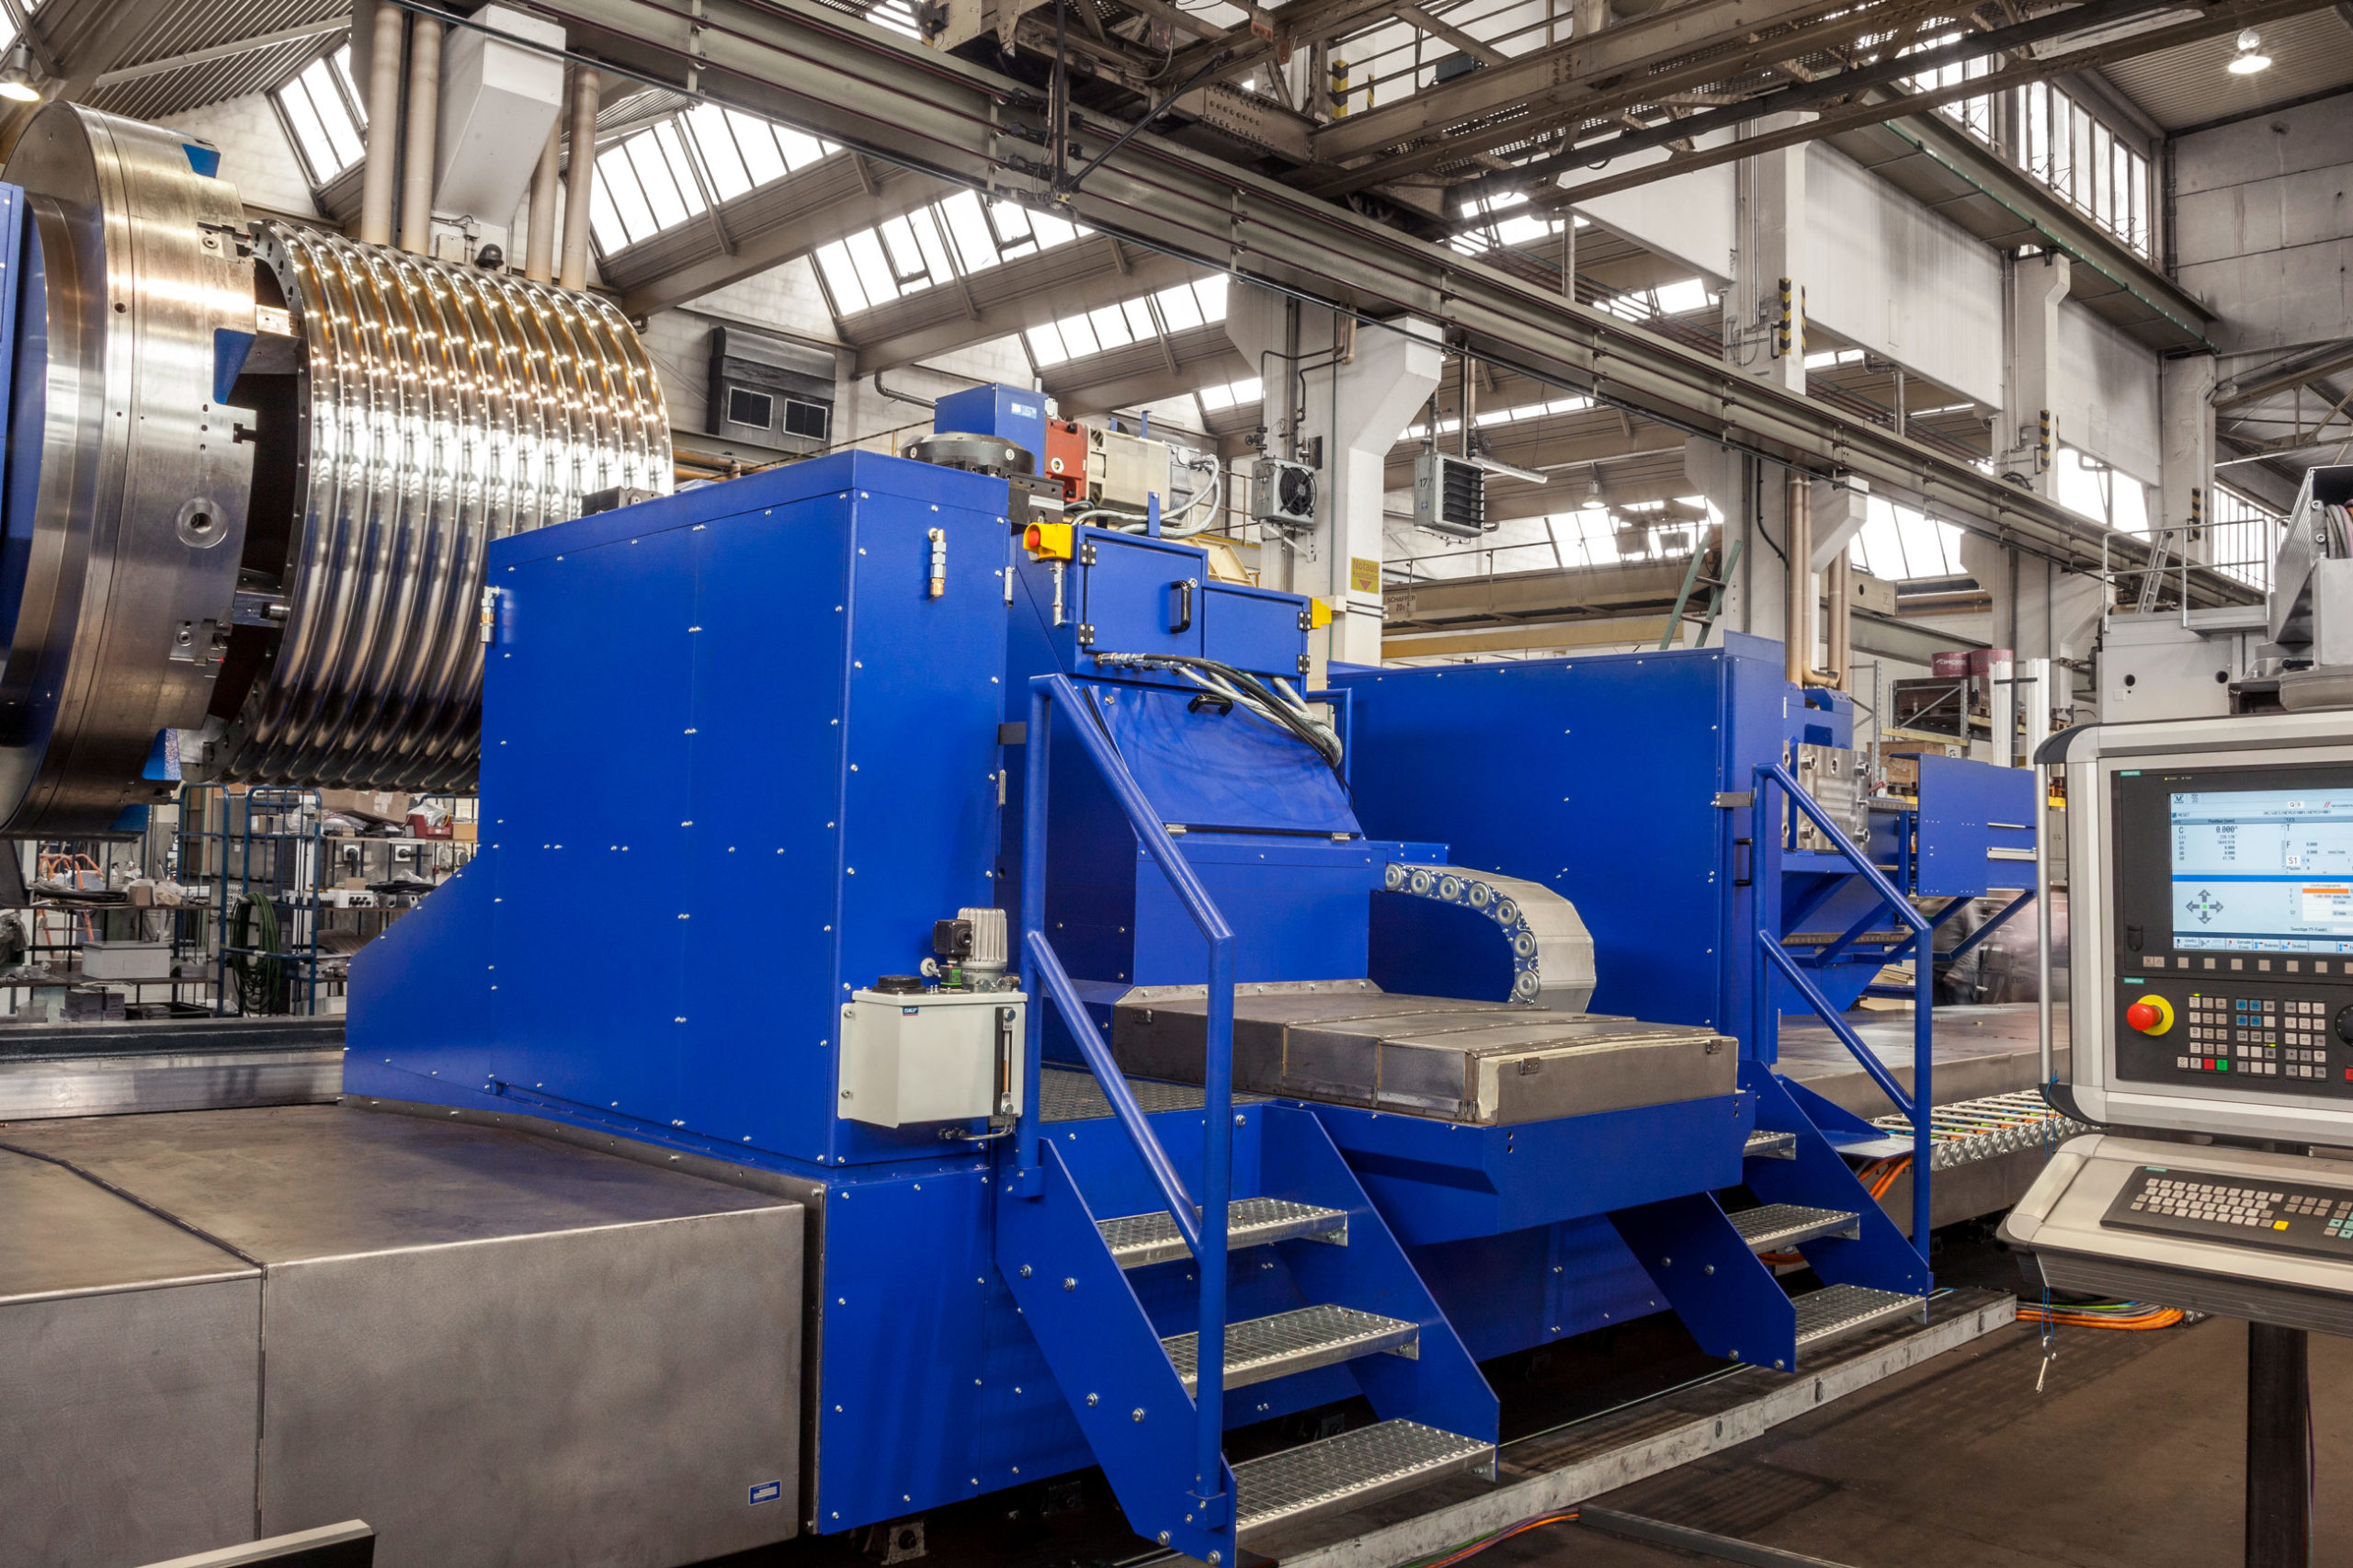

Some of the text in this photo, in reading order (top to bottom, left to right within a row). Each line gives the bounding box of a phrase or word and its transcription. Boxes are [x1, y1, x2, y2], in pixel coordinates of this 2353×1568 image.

[1420, 477, 1427, 487] 17
[1353, 558, 1379, 573] Notaus
[2288, 857, 2298, 865] S1
